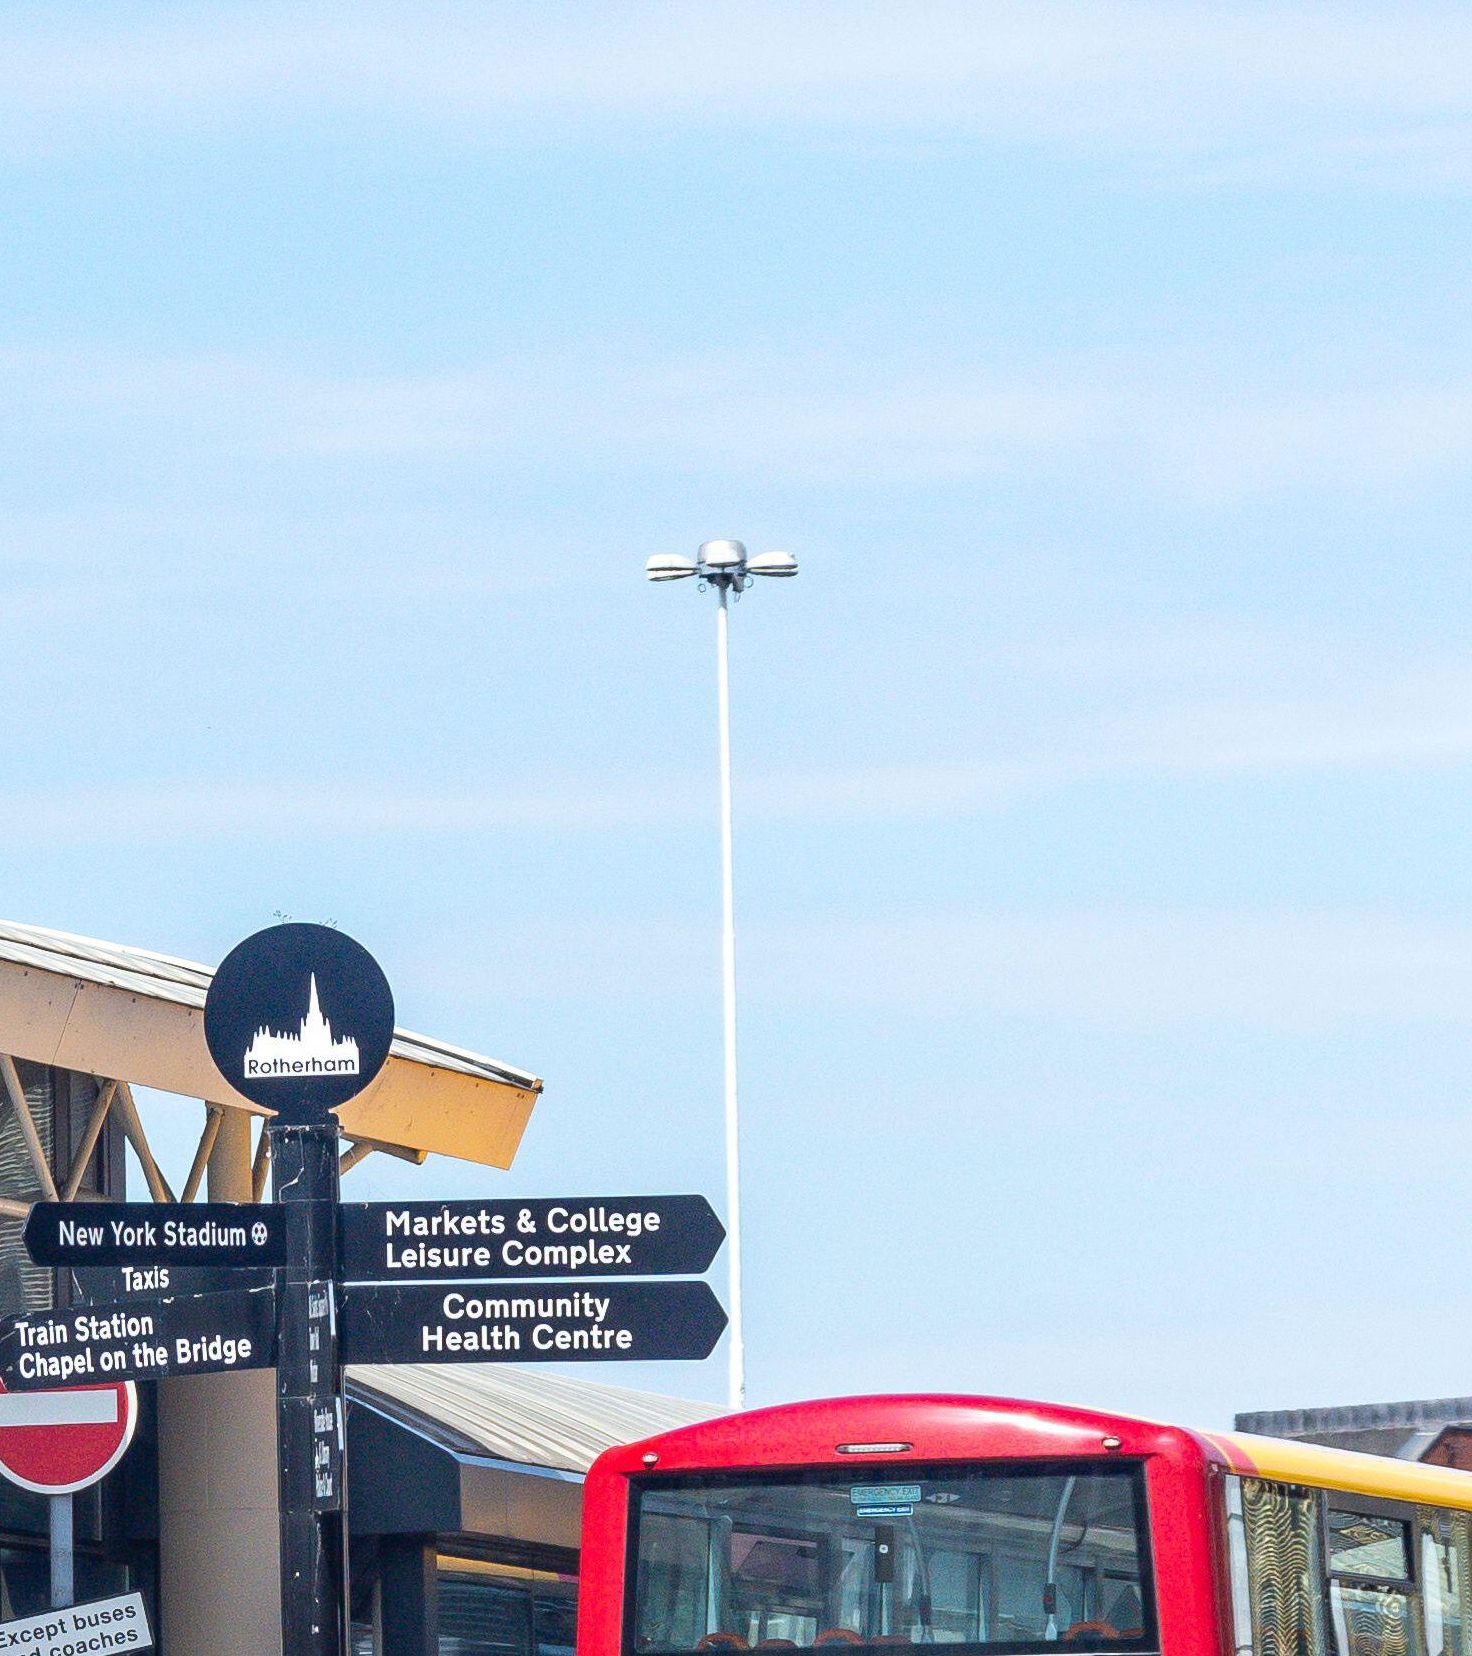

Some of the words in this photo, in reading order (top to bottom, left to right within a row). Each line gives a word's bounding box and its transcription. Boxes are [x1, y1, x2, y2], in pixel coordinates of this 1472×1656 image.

[248, 1057, 356, 1075] Rotherham
[58, 1221, 104, 1248] New
[111, 1220, 156, 1247] York
[163, 1220, 247, 1247] Stadium
[385, 1210, 504, 1237] Markets
[518, 1210, 537, 1233] &
[547, 1206, 660, 1239] College
[386, 1242, 492, 1268] Leisure
[503, 1238, 633, 1271] Complex
[122, 1266, 170, 1292] Taxis
[443, 1293, 609, 1325] Community
[15, 1317, 73, 1346] Train
[81, 1312, 154, 1340] Station
[422, 1324, 525, 1351] Health
[533, 1323, 633, 1350] Centre
[18, 1348, 92, 1380] Chapel
[99, 1350, 128, 1373] on
[134, 1342, 168, 1368] the
[176, 1334, 252, 1368] Bridge
[72, 1602, 137, 1633] buses
